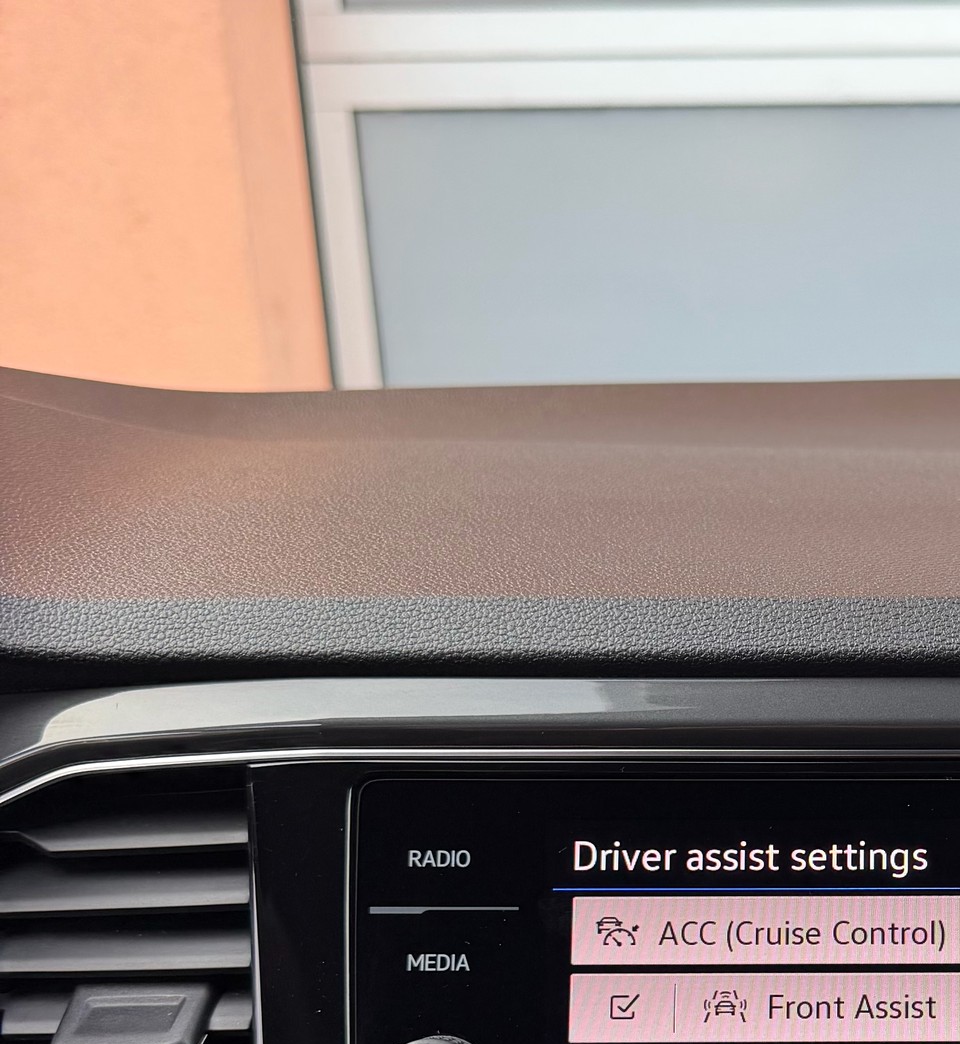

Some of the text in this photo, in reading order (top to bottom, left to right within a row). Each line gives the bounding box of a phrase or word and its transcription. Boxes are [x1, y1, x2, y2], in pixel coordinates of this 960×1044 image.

[408, 849, 471, 868] RADIO
[574, 840, 928, 879] Driver assist settings
[658, 919, 946, 953] ACC (Cruise Control)
[407, 953, 470, 972] MEDIA
[768, 993, 937, 1020] Front Assist
